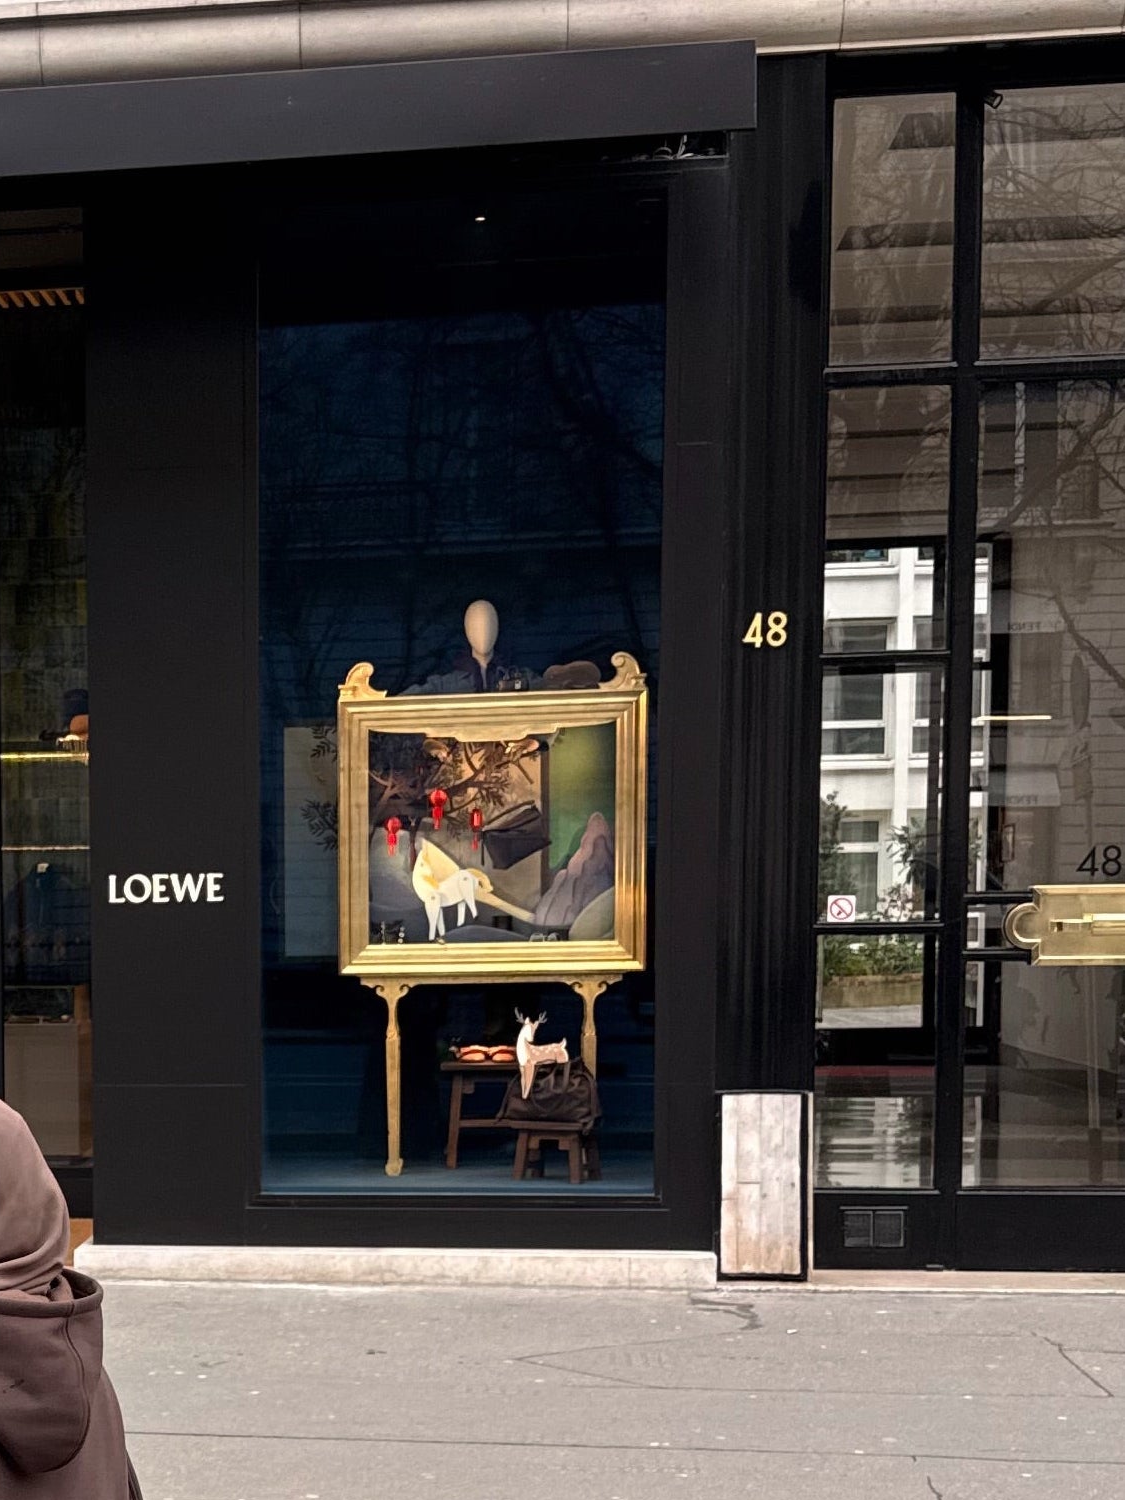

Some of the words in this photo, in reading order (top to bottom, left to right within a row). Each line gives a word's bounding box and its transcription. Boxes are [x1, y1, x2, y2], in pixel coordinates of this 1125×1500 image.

[741, 611, 788, 648] 48
[1075, 844, 1122, 877] 48
[108, 872, 225, 904] LOEWE
